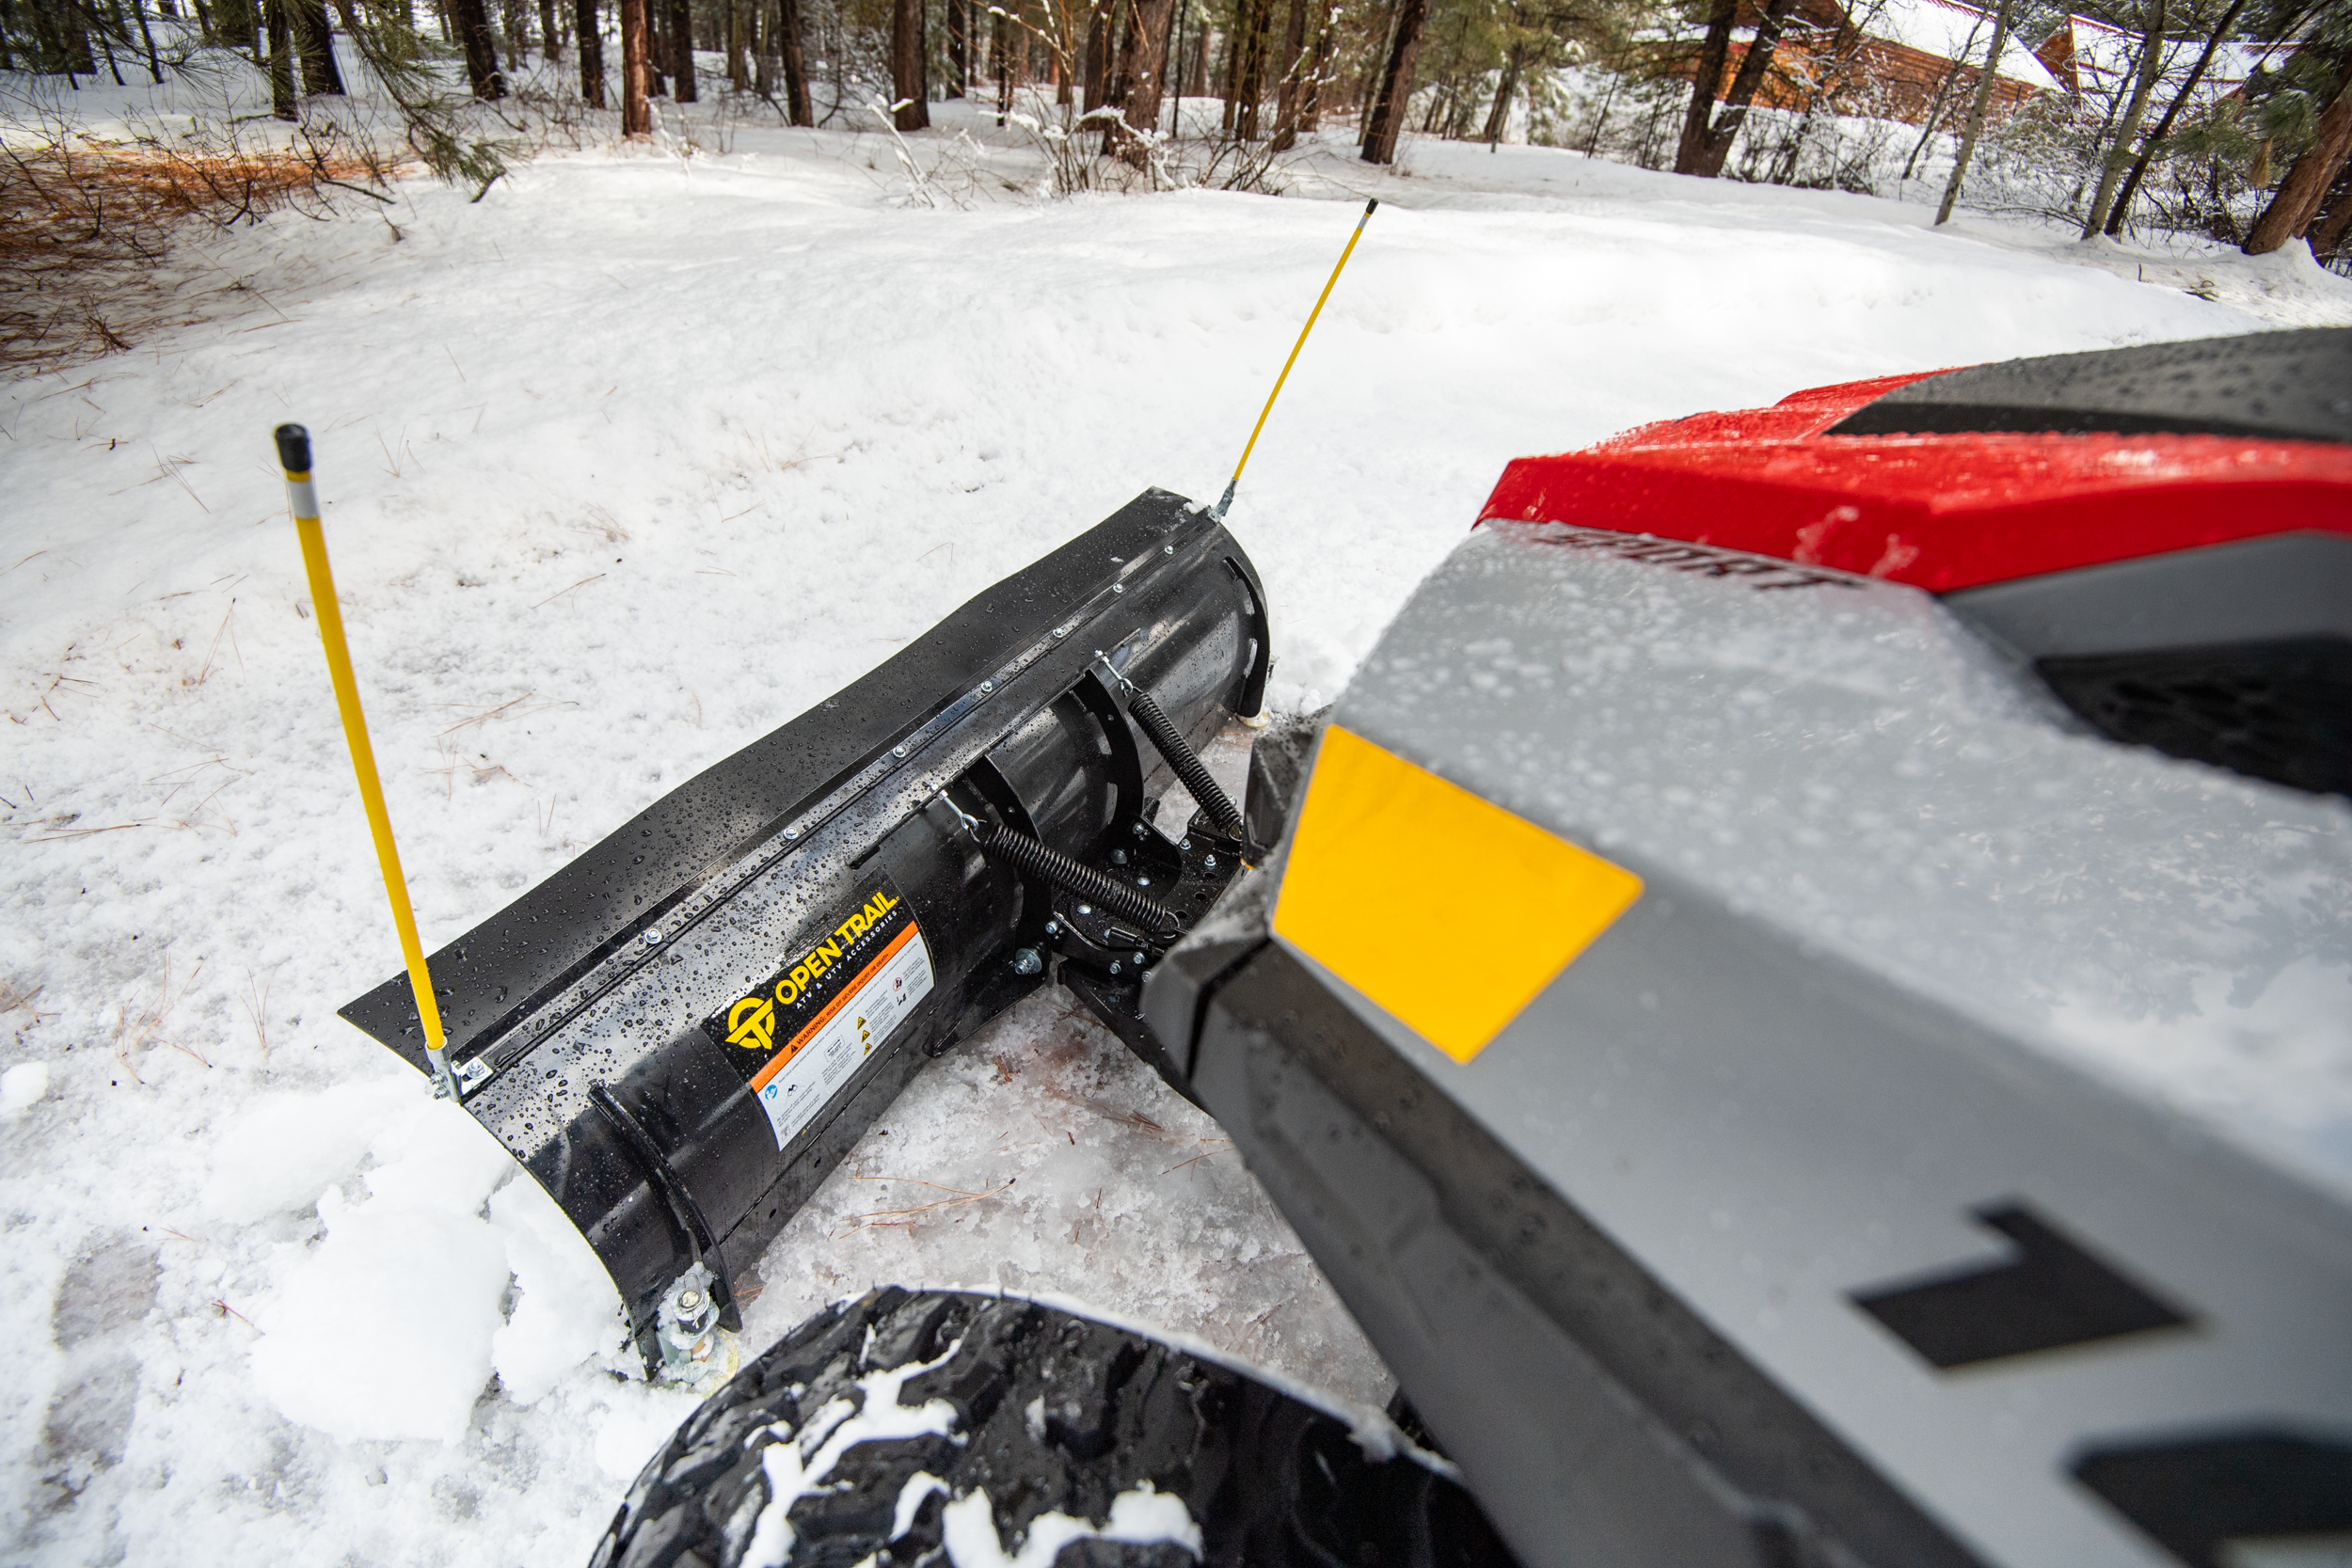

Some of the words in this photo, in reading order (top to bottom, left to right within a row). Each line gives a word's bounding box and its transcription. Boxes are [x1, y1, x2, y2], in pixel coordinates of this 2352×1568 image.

[775, 937, 843, 1005] OPEN
[834, 891, 898, 946] TRAIL
[796, 990, 813, 1009] ATV
[816, 982, 823, 990] &
[825, 962, 842, 980] UTV
[846, 910, 898, 961] ACCESSORIES
[796, 1016, 827, 1045] WARNING:
[826, 1006, 836, 1017] RISK
[842, 984, 857, 1001] SEVERE
[876, 953, 889, 968] DEATH
